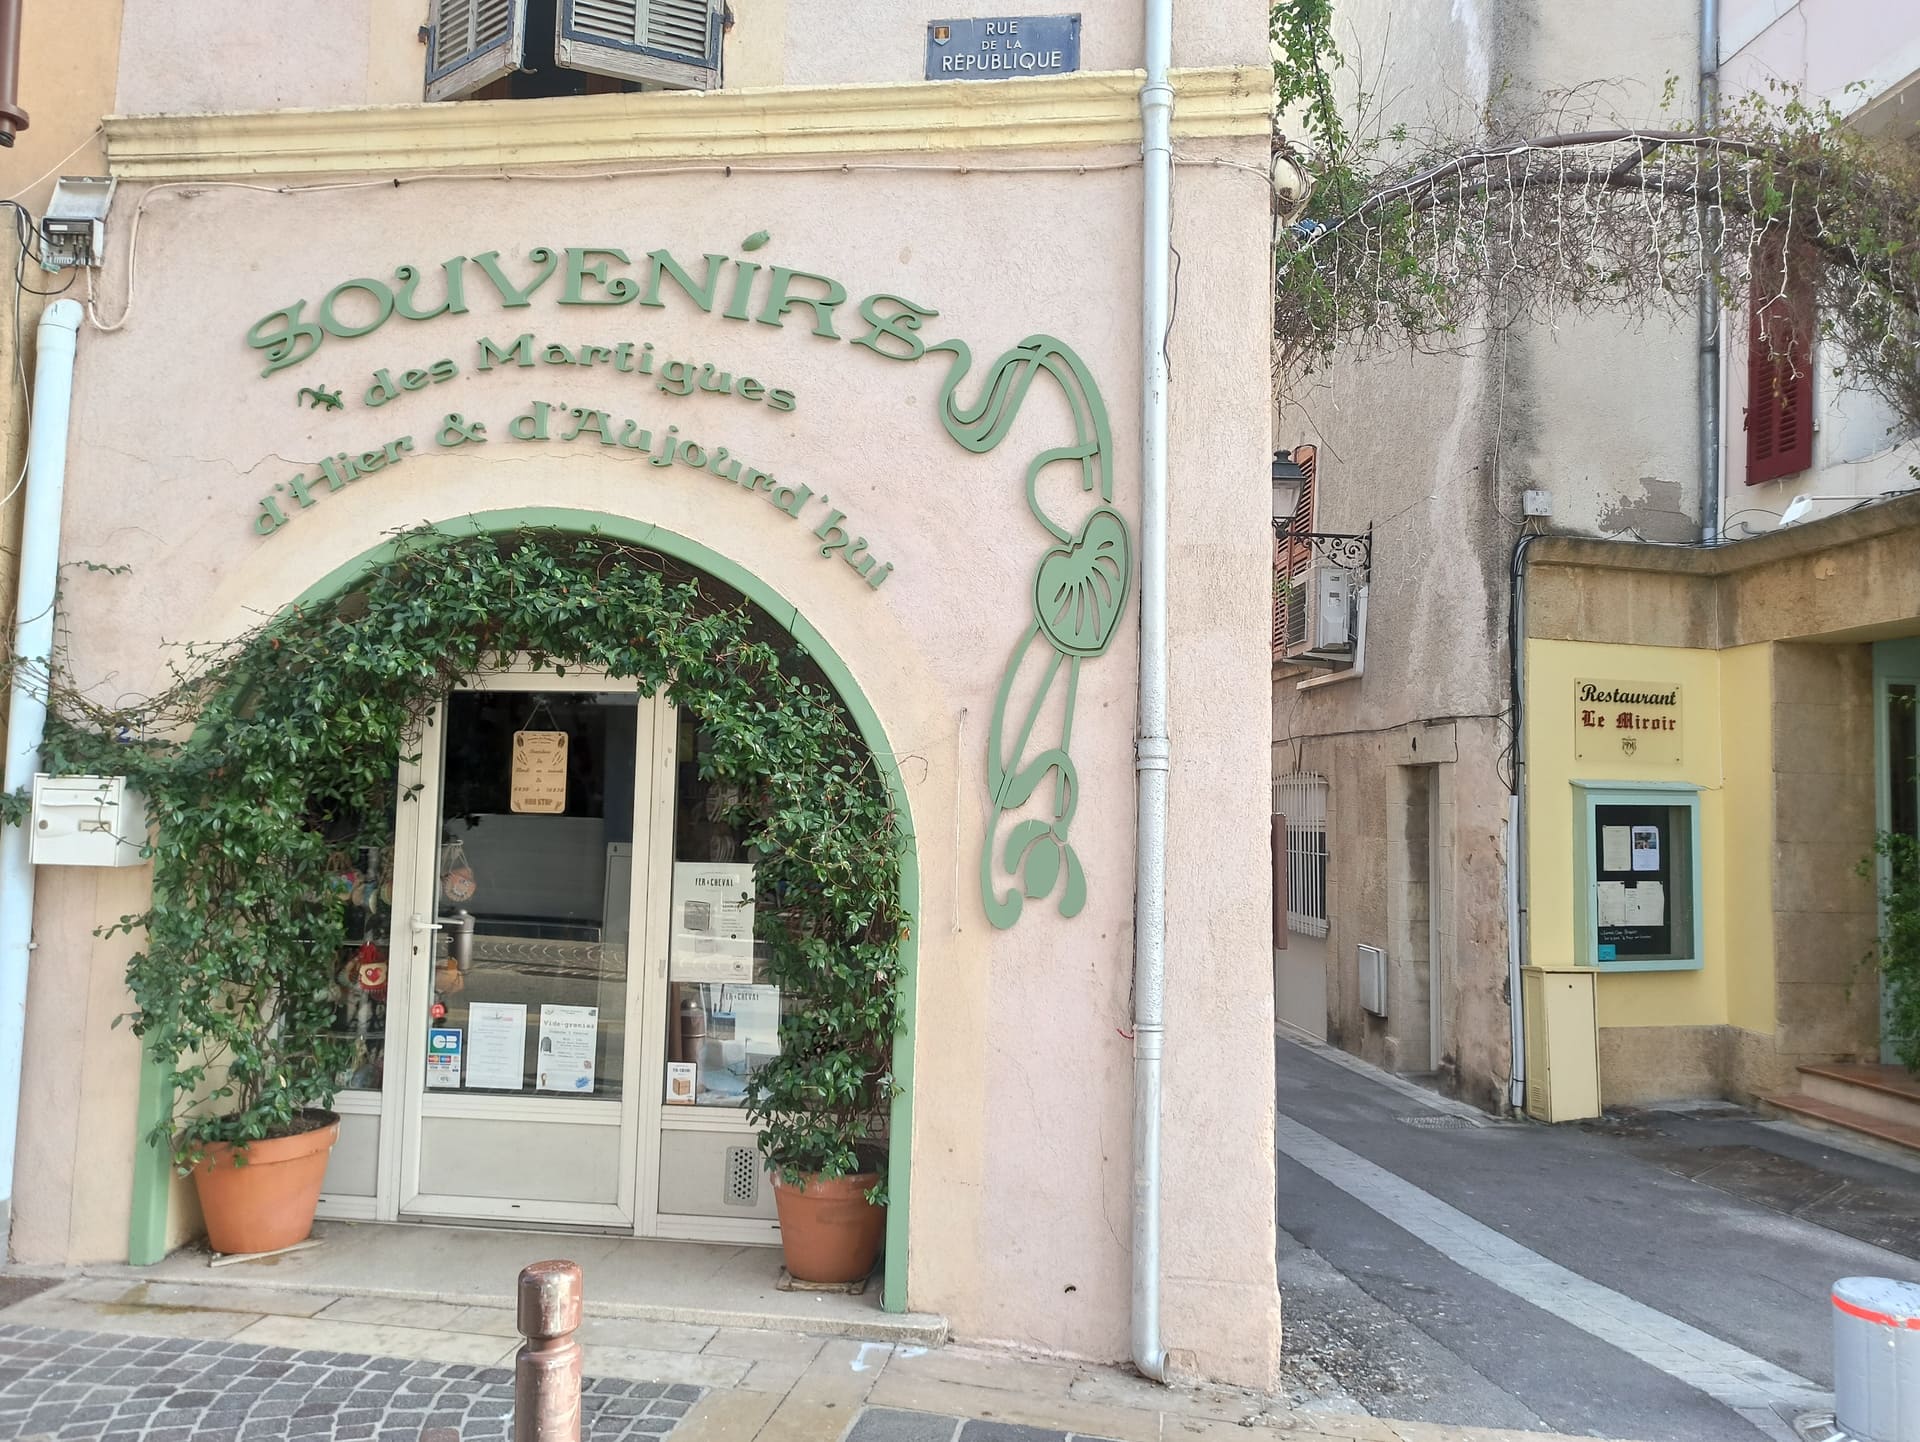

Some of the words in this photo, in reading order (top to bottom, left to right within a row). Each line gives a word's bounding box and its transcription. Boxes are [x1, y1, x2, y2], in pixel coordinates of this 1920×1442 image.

[986, 21, 1018, 35] RUE
[981, 41, 997, 50] DE
[1006, 40, 1022, 49] LA
[942, 51, 1062, 71] RÉPUBLIQUE
[246, 246, 940, 378] SOUVENIRS
[363, 355, 460, 408] des
[476, 333, 797, 412] Martigues
[252, 434, 415, 536] d'Hier
[435, 412, 489, 448] &
[1580, 683, 1677, 706] Restaurant
[1581, 709, 1605, 728] Le
[1615, 711, 1677, 731] Miroir
